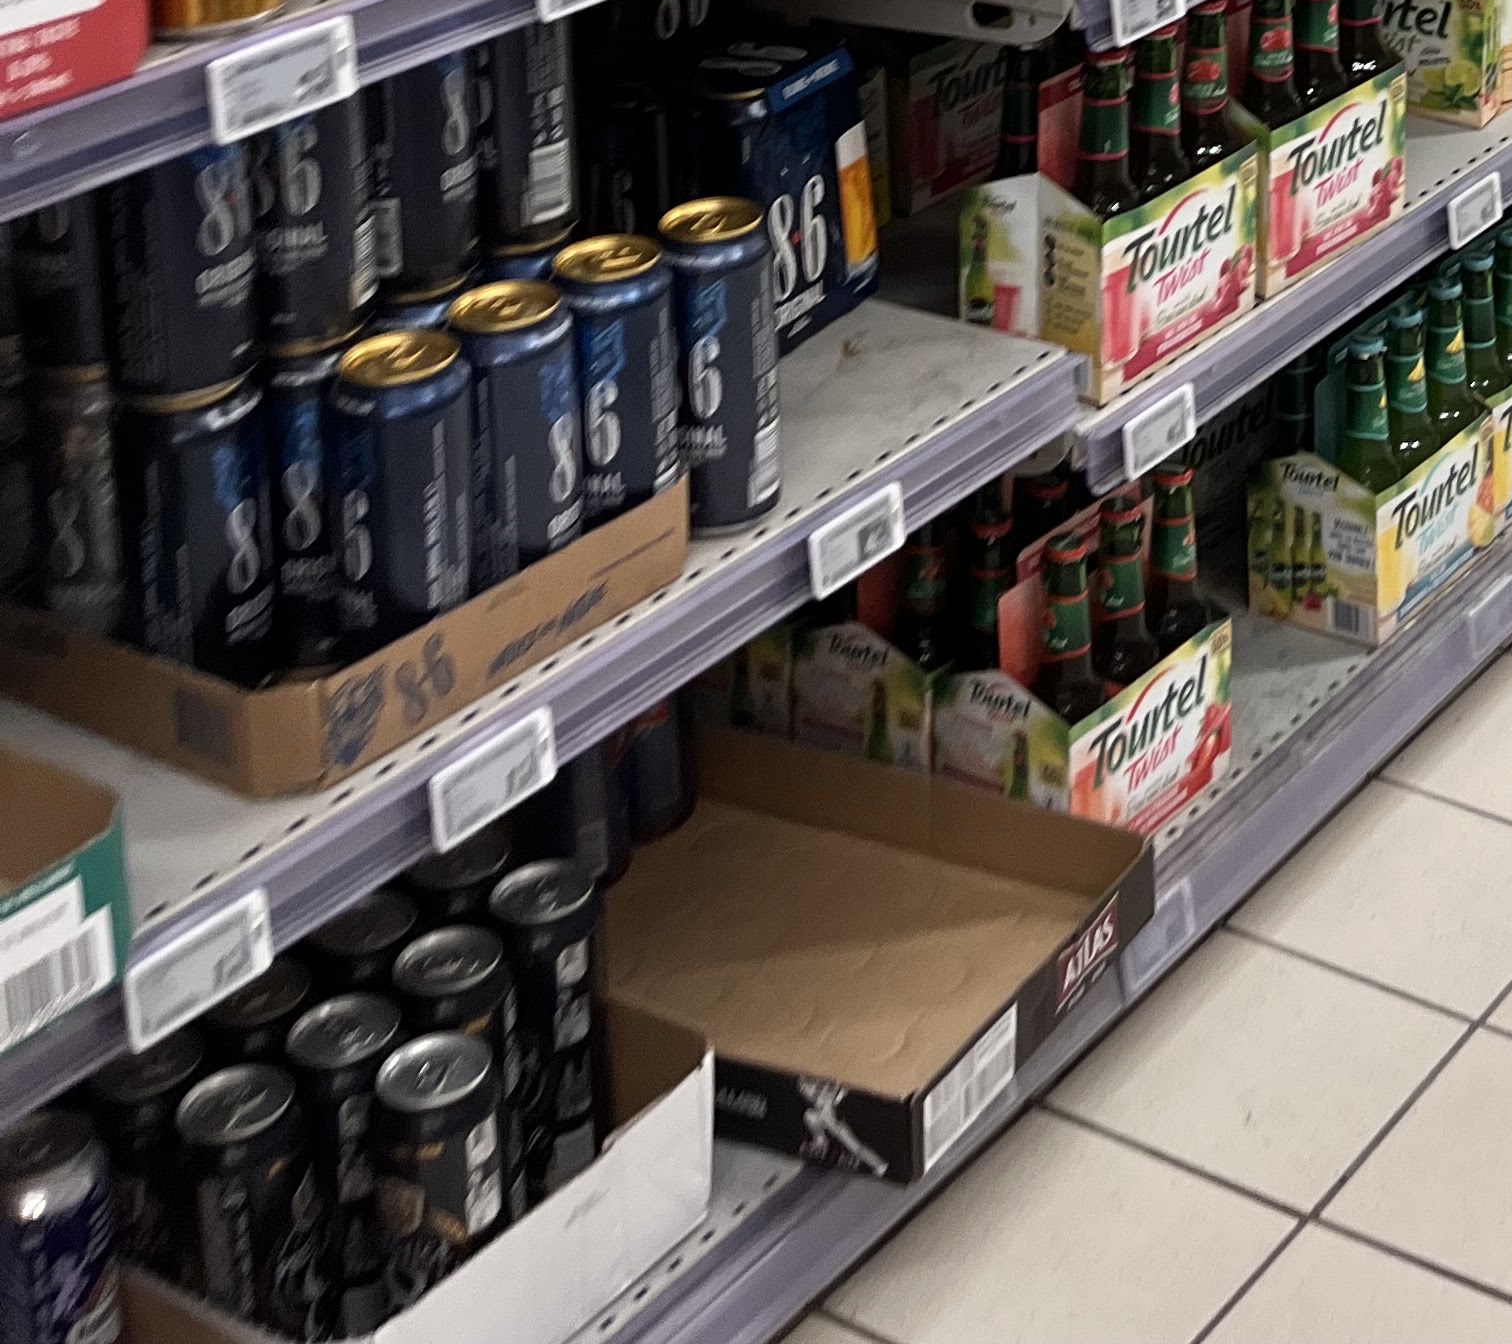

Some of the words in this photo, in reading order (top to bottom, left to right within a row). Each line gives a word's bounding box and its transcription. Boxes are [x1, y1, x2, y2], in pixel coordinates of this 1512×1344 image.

[1286, 99, 1388, 197] Tourtel
[1314, 159, 1364, 208] Twist
[1123, 185, 1238, 293] Tourtel
[1153, 248, 1212, 301] Twist
[1392, 442, 1480, 551] Tourtel
[1090, 653, 1207, 789] Tourtel
[1123, 725, 1182, 794] Twist
[1062, 910, 1115, 995] ATLAS
